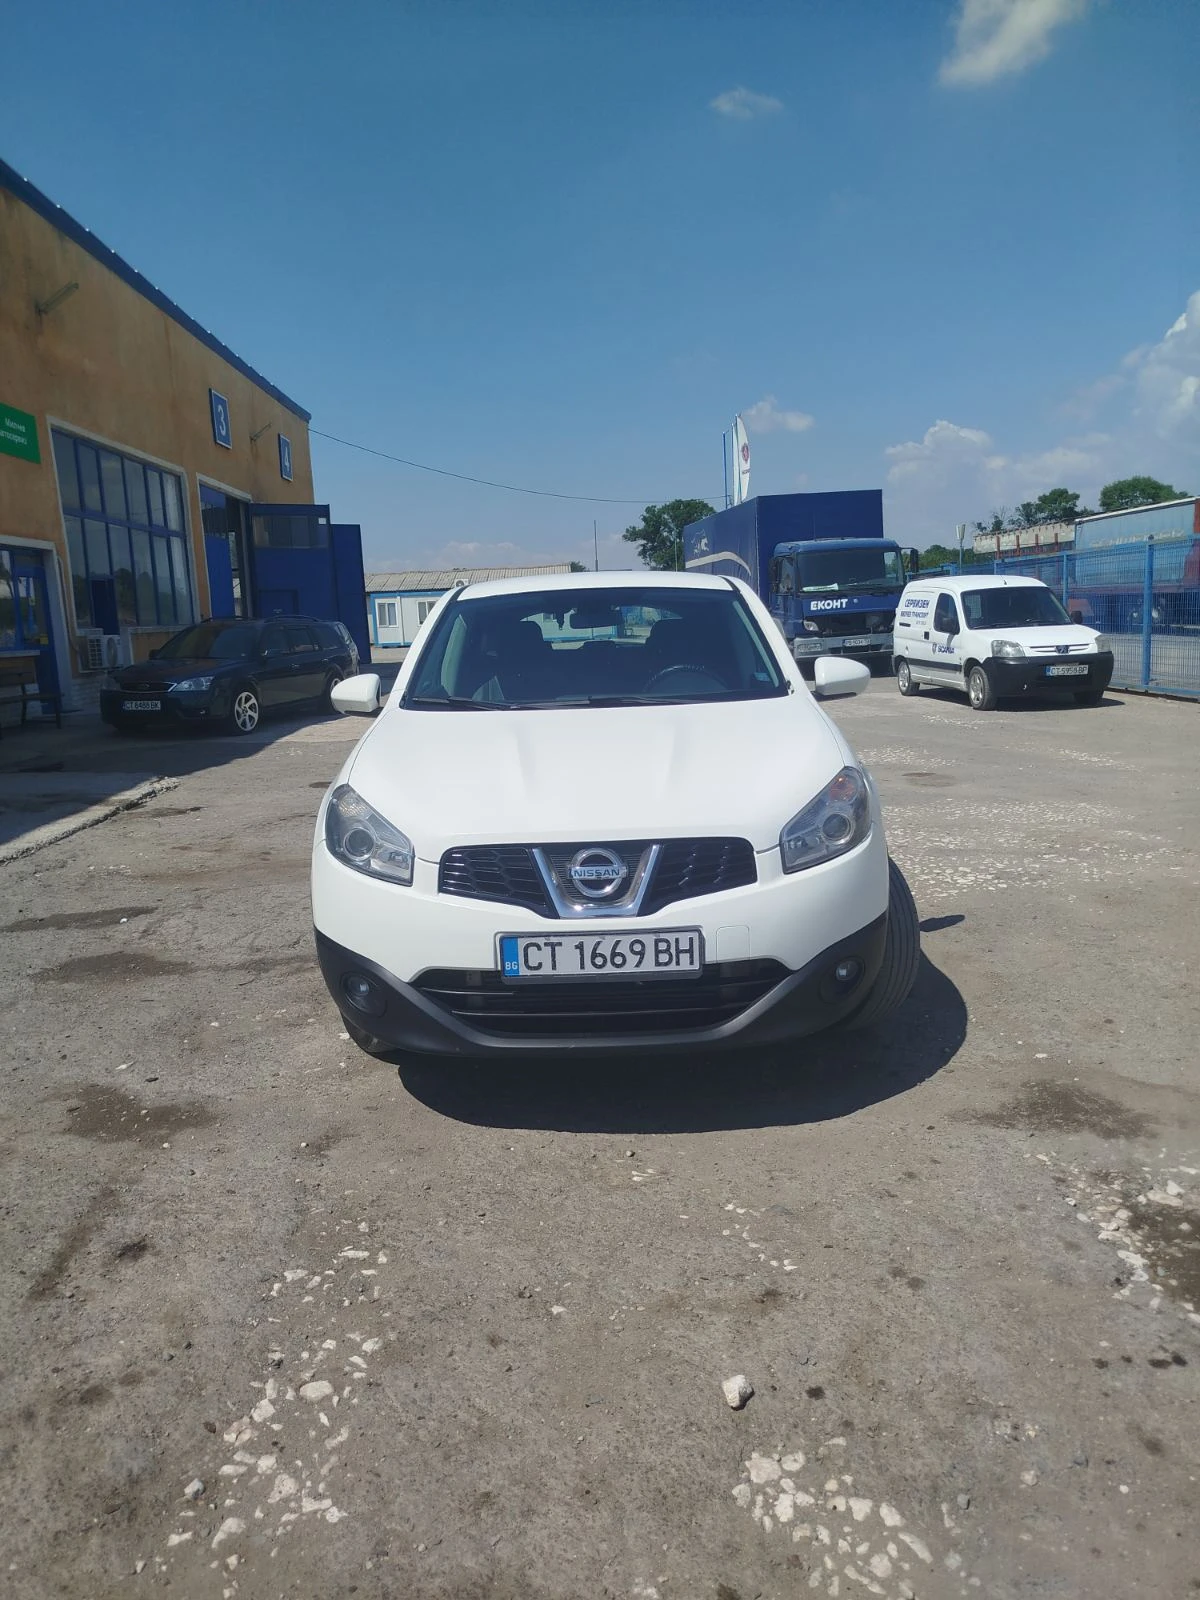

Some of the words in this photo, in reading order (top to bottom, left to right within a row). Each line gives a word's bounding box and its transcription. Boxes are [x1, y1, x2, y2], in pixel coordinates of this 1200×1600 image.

[217, 404, 227, 437] 3
[284, 446, 291, 471] 4
[810, 598, 848, 611] ЕКОНТ
[572, 868, 620, 878] NISSAN
[523, 941, 563, 972] CT
[573, 939, 646, 971] 1669
[653, 936, 694, 967] BH
[505, 961, 518, 970] BG
